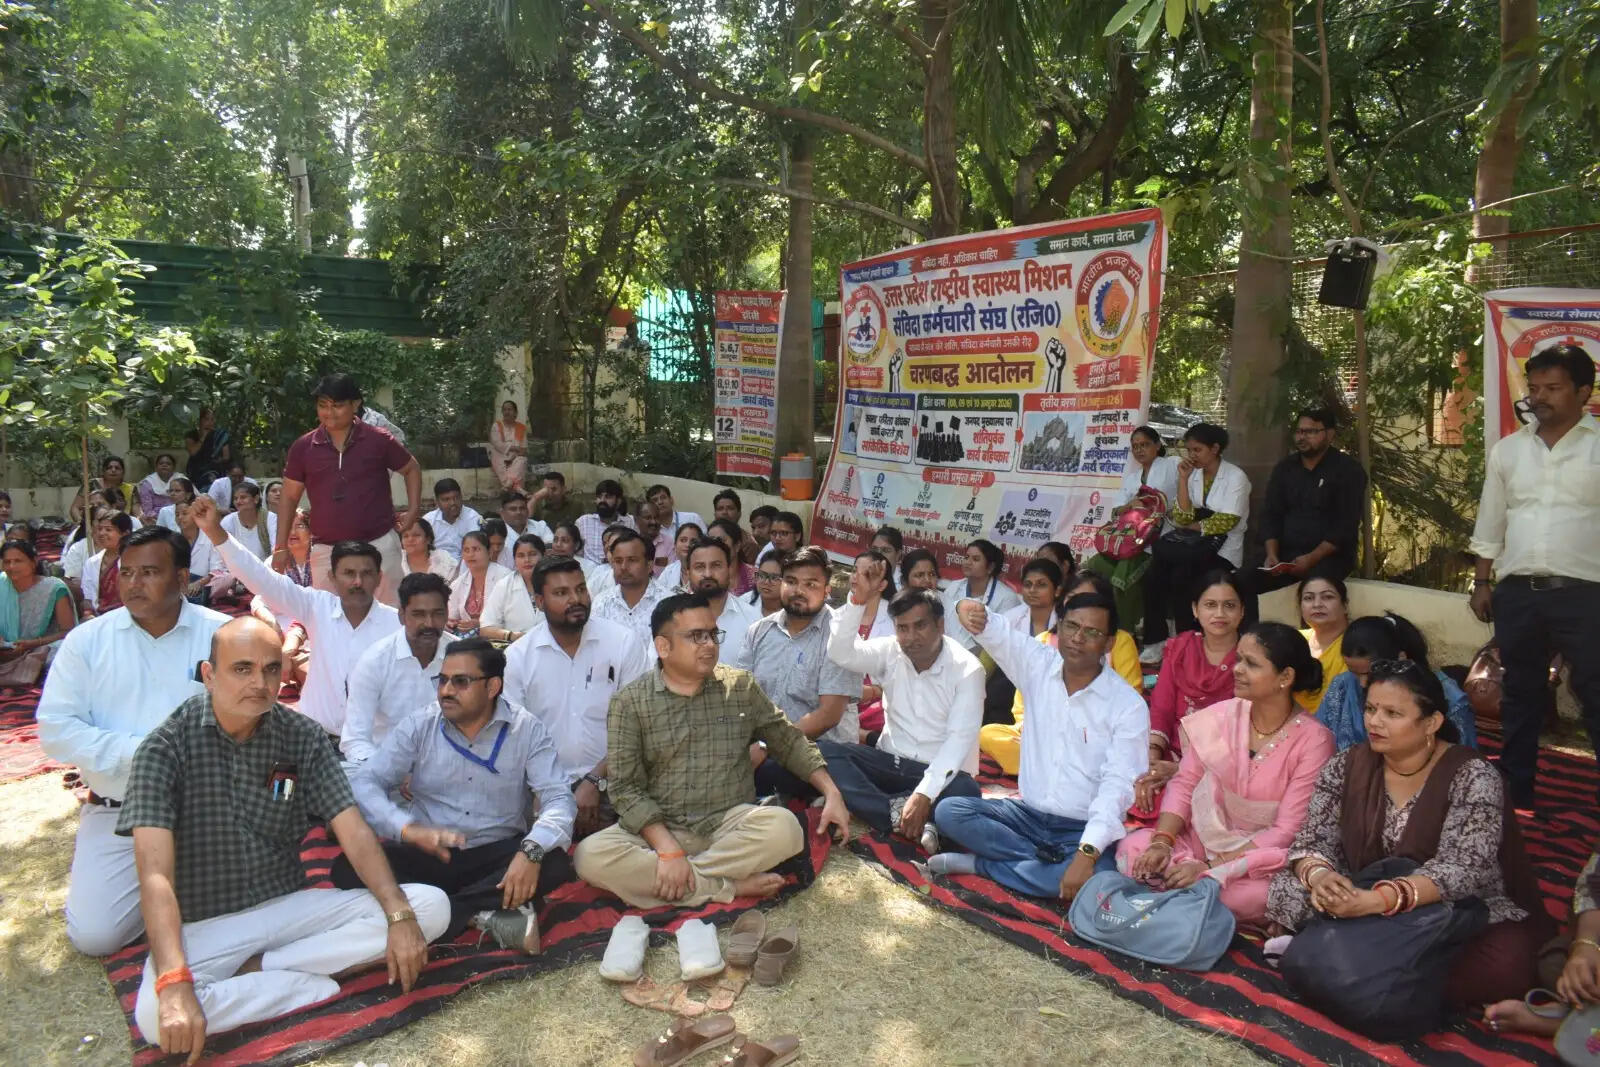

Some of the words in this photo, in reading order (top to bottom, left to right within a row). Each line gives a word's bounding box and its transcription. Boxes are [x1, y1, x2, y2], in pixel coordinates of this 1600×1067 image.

[1049, 239, 1069, 250] समान
[1071, 233, 1090, 248] कार्य,
[1093, 233, 1114, 245] समान
[1116, 229, 1135, 241] वेतन
[979, 247, 998, 260] चाहिए
[883, 285, 902, 308] उत्तर
[903, 275, 929, 306] प्रदेश
[931, 269, 970, 305] राष्ट्रीय
[972, 268, 1021, 298] स्वास्थ्य
[1023, 258, 1073, 293] मिशन
[1081, 262, 1103, 294] भारतीय
[1105, 255, 1129, 269] मजदू
[893, 310, 921, 337] संविदा
[922, 302, 976, 334] कर्मचारी
[978, 301, 1008, 331] संघ
[1527, 311, 1565, 320] स्वास्थ्य
[910, 363, 960, 388] चरणबद्ध
[1040, 395, 1060, 412] तृतीय
[1061, 399, 1076, 408] चरण
[717, 417, 734, 432] 12
[965, 417, 980, 426] जनपद
[1005, 417, 1013, 427] पर
[1122, 411, 1130, 422] से
[1099, 460, 1125, 473] बहिष्का
[931, 468, 950, 481] हमारी
[951, 472, 969, 485] प्रमुख
